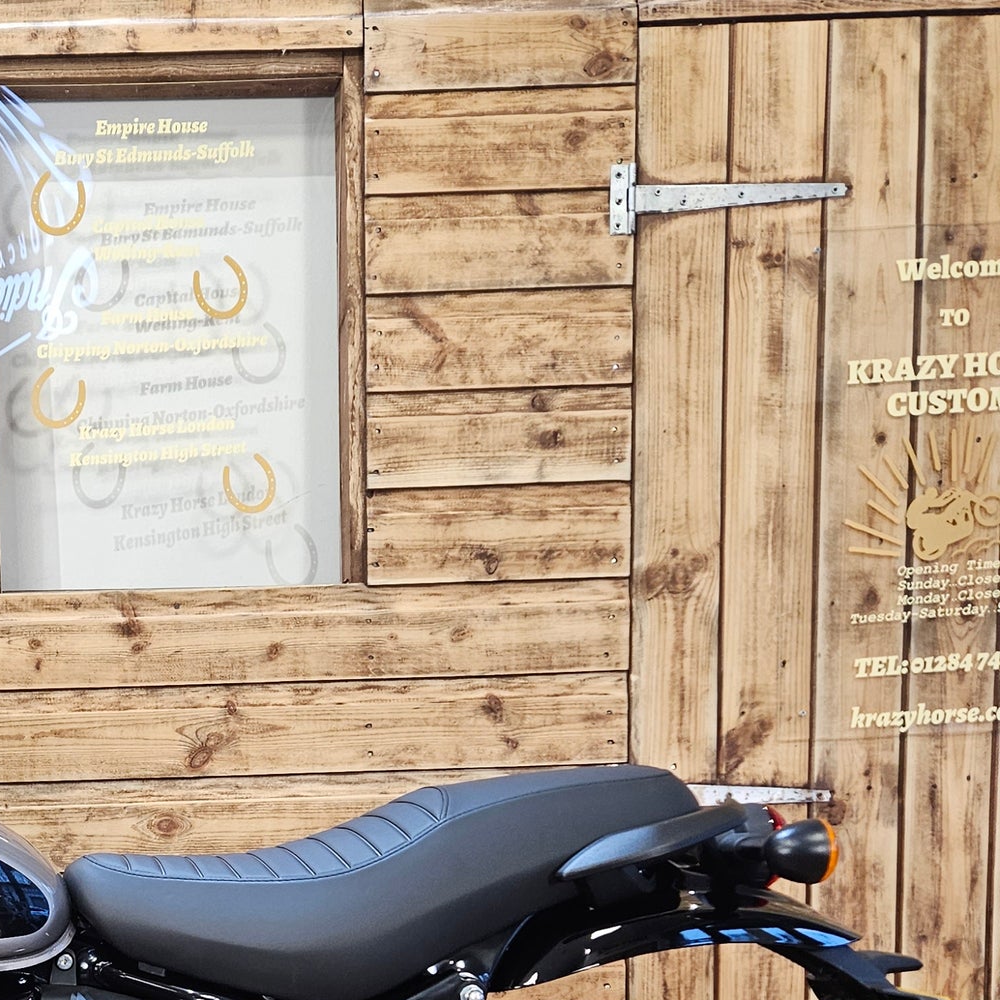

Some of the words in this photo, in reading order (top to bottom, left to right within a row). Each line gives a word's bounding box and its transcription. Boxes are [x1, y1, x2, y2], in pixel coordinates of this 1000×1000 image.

[95, 119, 156, 139] Empire
[158, 118, 208, 134] House
[54, 149, 95, 169] Bury
[96, 147, 113, 164] St
[115, 141, 255, 164] Edmunds-Suffolk
[144, 198, 203, 219] Empire
[204, 198, 256, 214] House
[940, 308, 971, 326] TO
[847, 354, 959, 385] KRAZY
[140, 380, 183, 397] Farm
[186, 374, 233, 390] House
[77, 425, 126, 443] Krazy
[128, 421, 175, 439] Horse
[177, 418, 236, 434] London
[68, 450, 158, 468] Kensington
[160, 445, 199, 462] High
[897, 562, 959, 579] Opening
